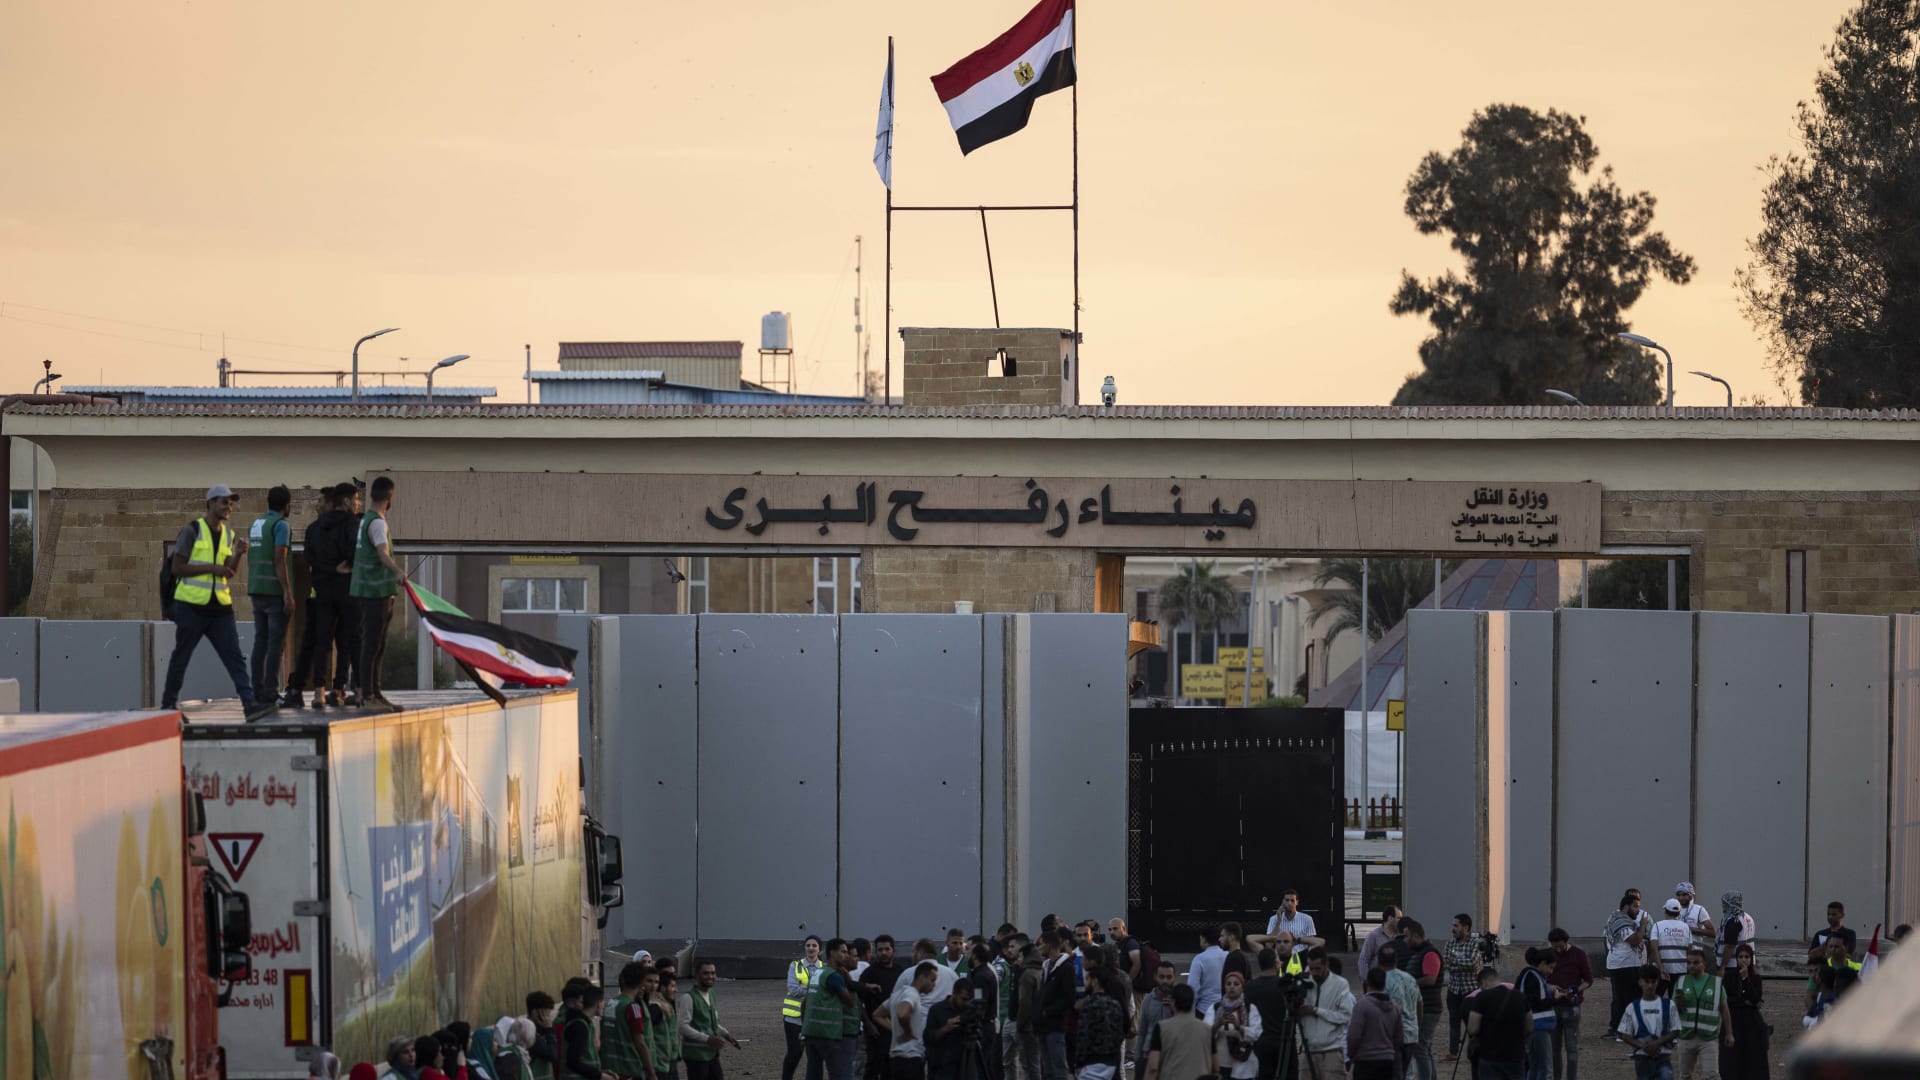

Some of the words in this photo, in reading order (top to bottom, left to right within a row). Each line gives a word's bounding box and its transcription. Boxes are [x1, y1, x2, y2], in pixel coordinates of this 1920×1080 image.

[1466, 487, 1503, 509] النقل
[1508, 488, 1549, 509] وزارة
[887, 478, 1070, 540] رفح
[1078, 483, 1257, 541] ميناء
[1492, 513, 1524, 525] العامة
[1454, 529, 1514, 547] والجافة
[1518, 531, 1559, 547] البرية
[263, 968, 279, 986] 48
